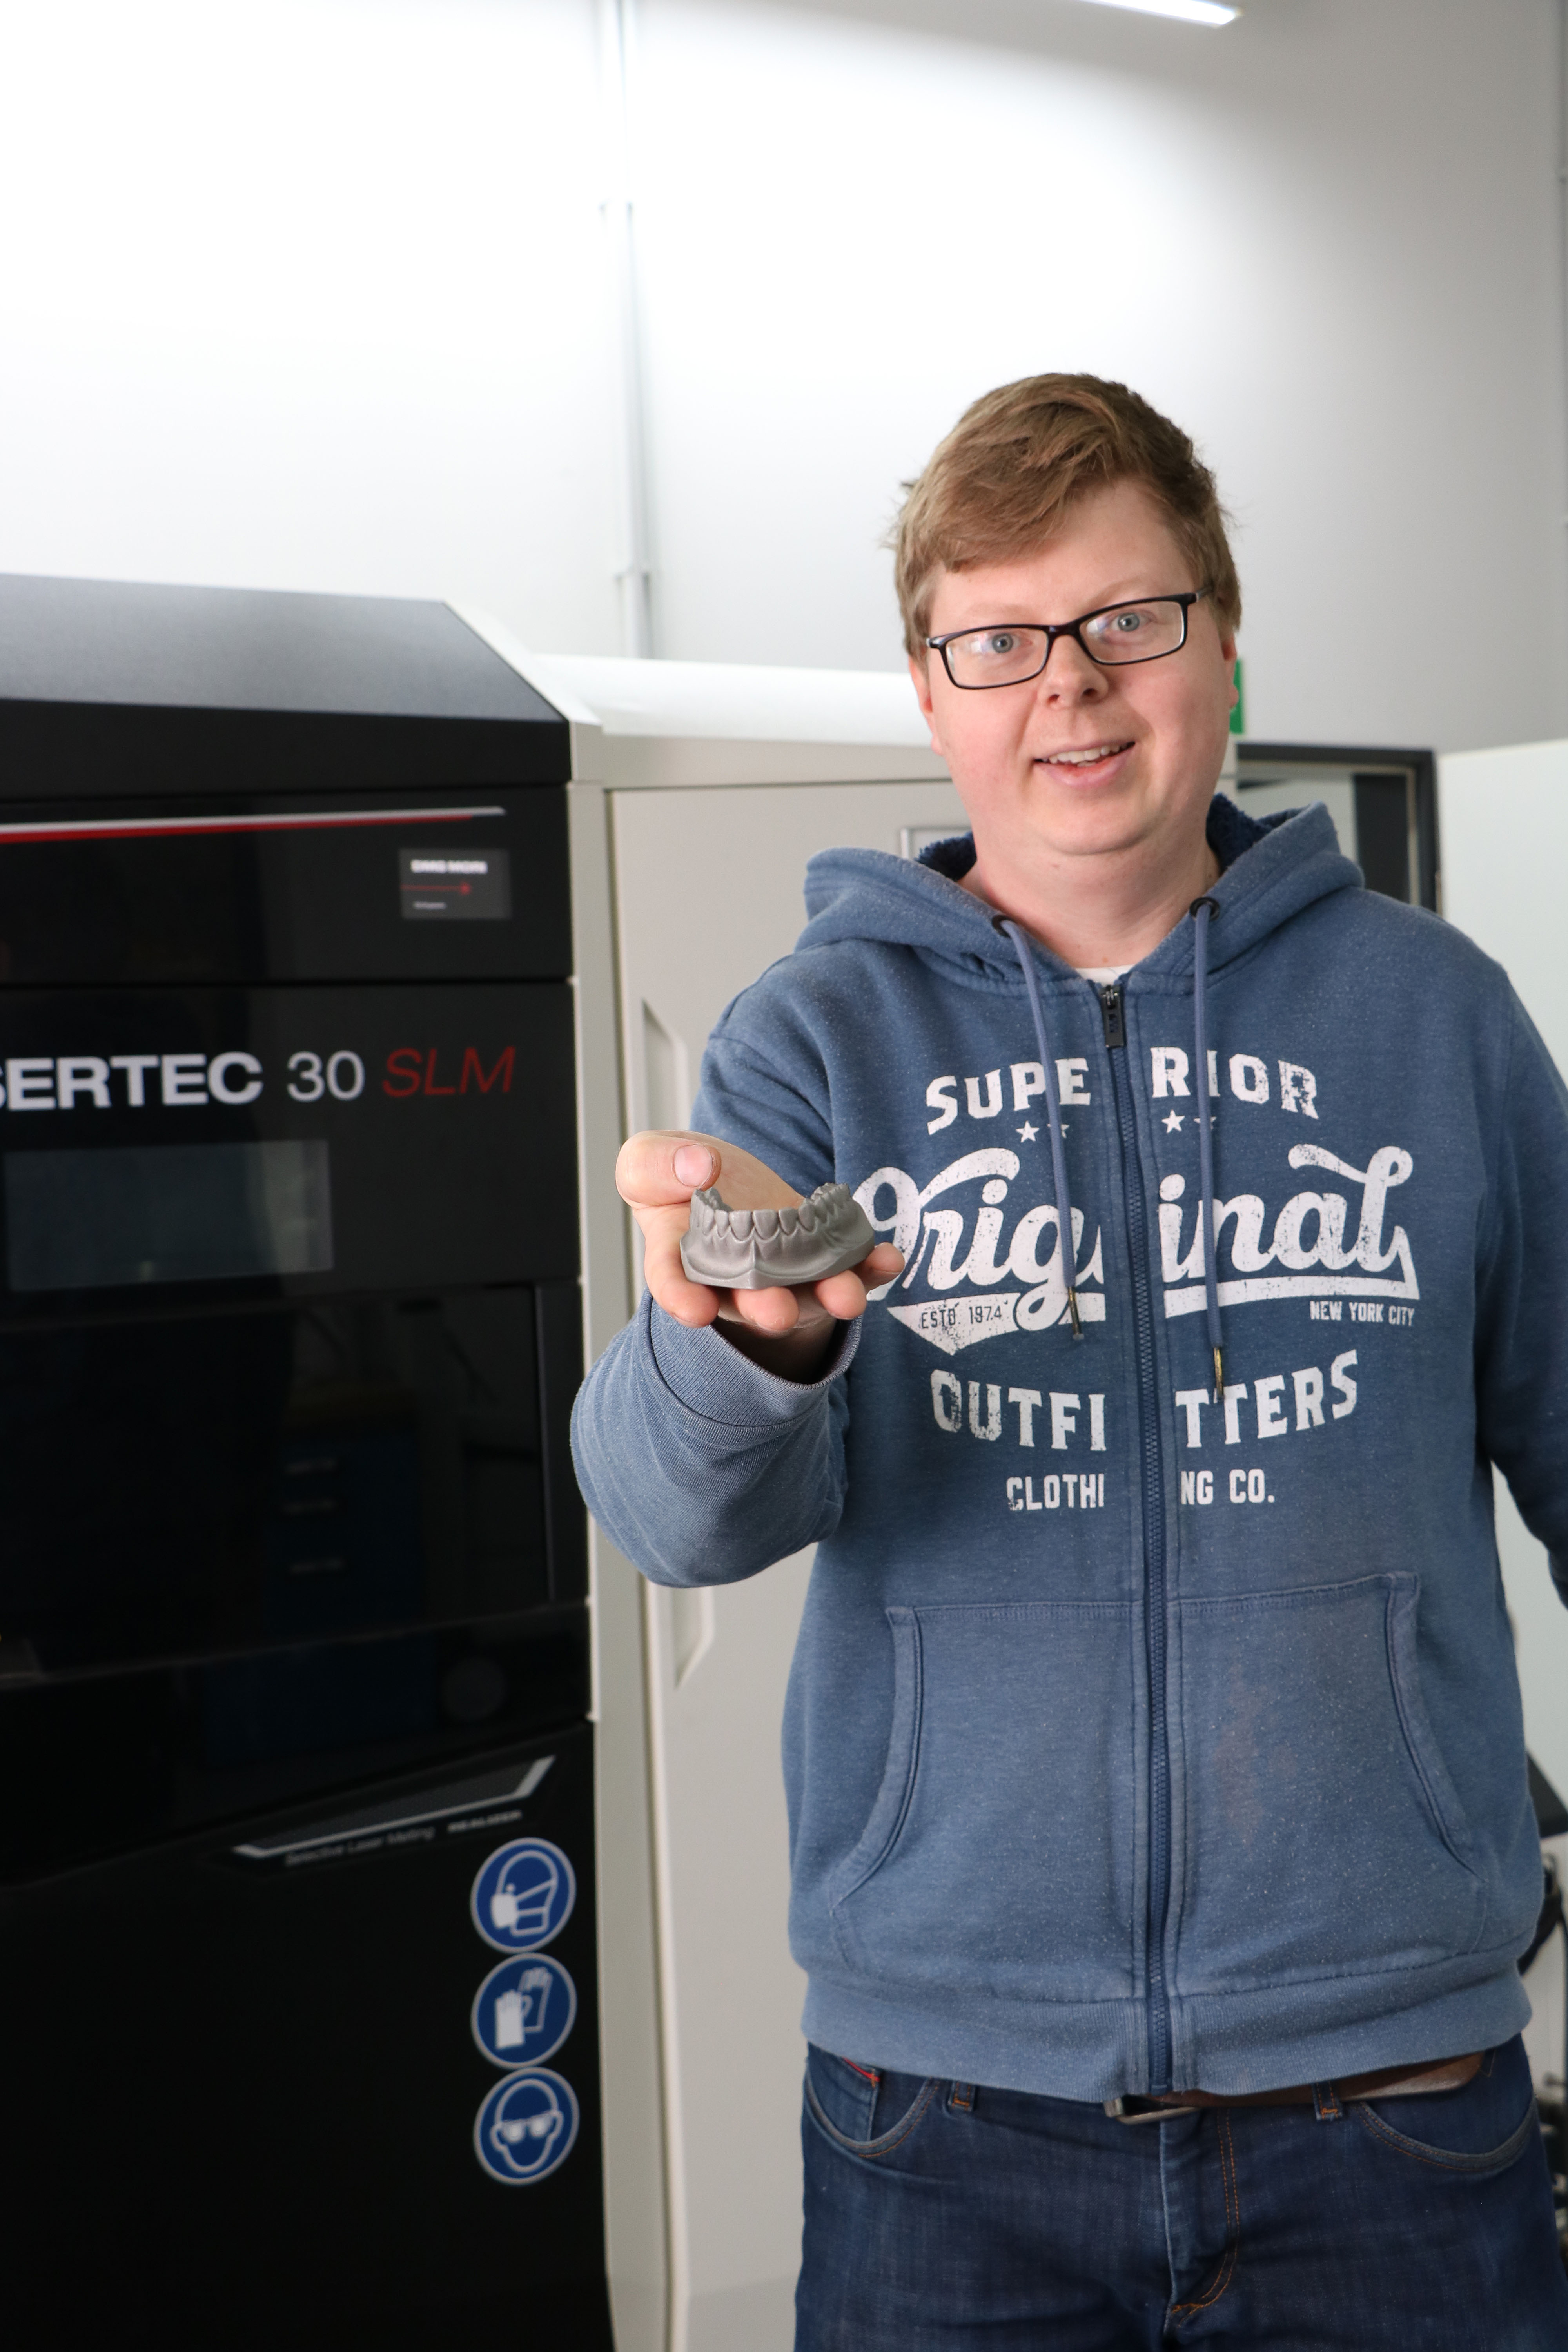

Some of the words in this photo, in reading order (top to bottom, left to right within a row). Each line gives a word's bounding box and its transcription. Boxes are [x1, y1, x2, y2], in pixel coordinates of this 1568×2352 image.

[0, 1051, 263, 1111] ERTEC
[287, 1050, 365, 1102] 30
[382, 1045, 516, 1098] SLM
[1309, 1300, 1343, 1321] NEW
[1348, 1301, 1384, 1323] YORK
[1388, 1305, 1415, 1327] CITY
[1229, 1468, 1275, 1503] CO.
